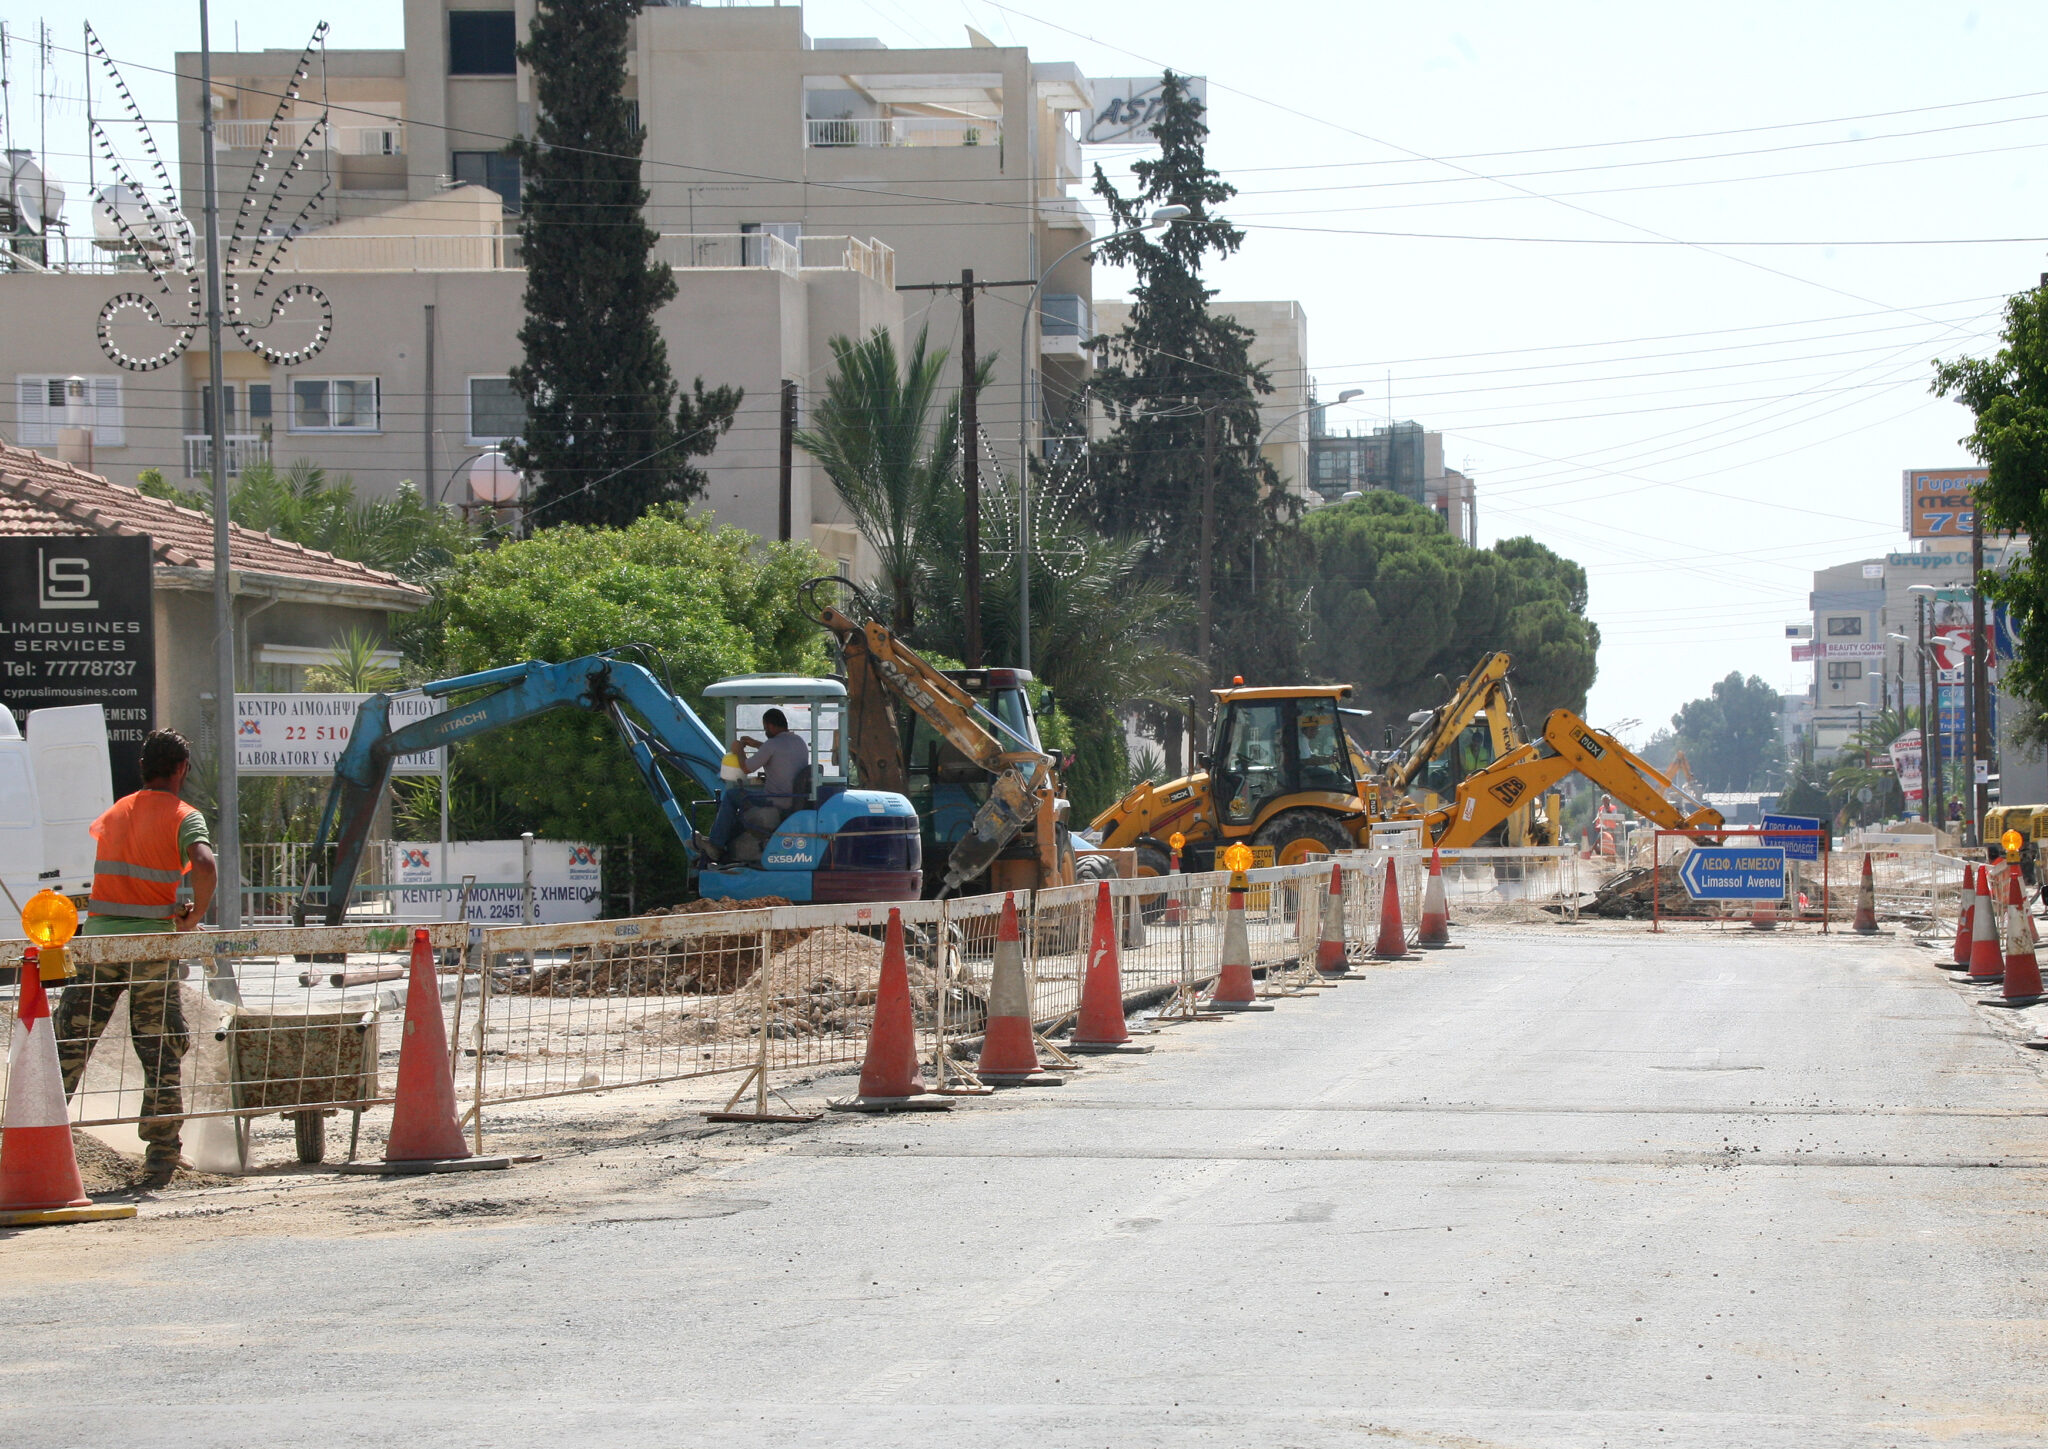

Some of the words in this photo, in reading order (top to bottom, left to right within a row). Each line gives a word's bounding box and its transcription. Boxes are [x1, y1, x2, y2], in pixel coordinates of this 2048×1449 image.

[1923, 513, 1974, 532] 75
[0, 622, 140, 633] LIMOUSINES
[14, 640, 126, 652] SERVICES
[4, 661, 36, 676] Tel:
[45, 661, 136, 676] 77778737
[881, 661, 935, 709] CASE
[4, 687, 138, 698] cypruslimousines.com
[105, 708, 147, 720] EMENTS
[239, 701, 287, 716] ΚΕΝΤΡΟ
[292, 701, 356, 716] ΑΙΜΟΛΗΨΙ
[107, 729, 143, 741] ARTIES
[286, 727, 306, 740] 22
[317, 726, 349, 740] 510
[238, 752, 319, 765] LABORATORY
[397, 751, 435, 765] ENTRE
[1495, 778, 1525, 803] JCB
[1702, 858, 1733, 870] ΛΕΩΦ.
[1735, 858, 1781, 870] ΛΕΜΕΣΟΥ
[1702, 876, 1742, 888] Limassol
[1747, 876, 1781, 888] Aveneu
